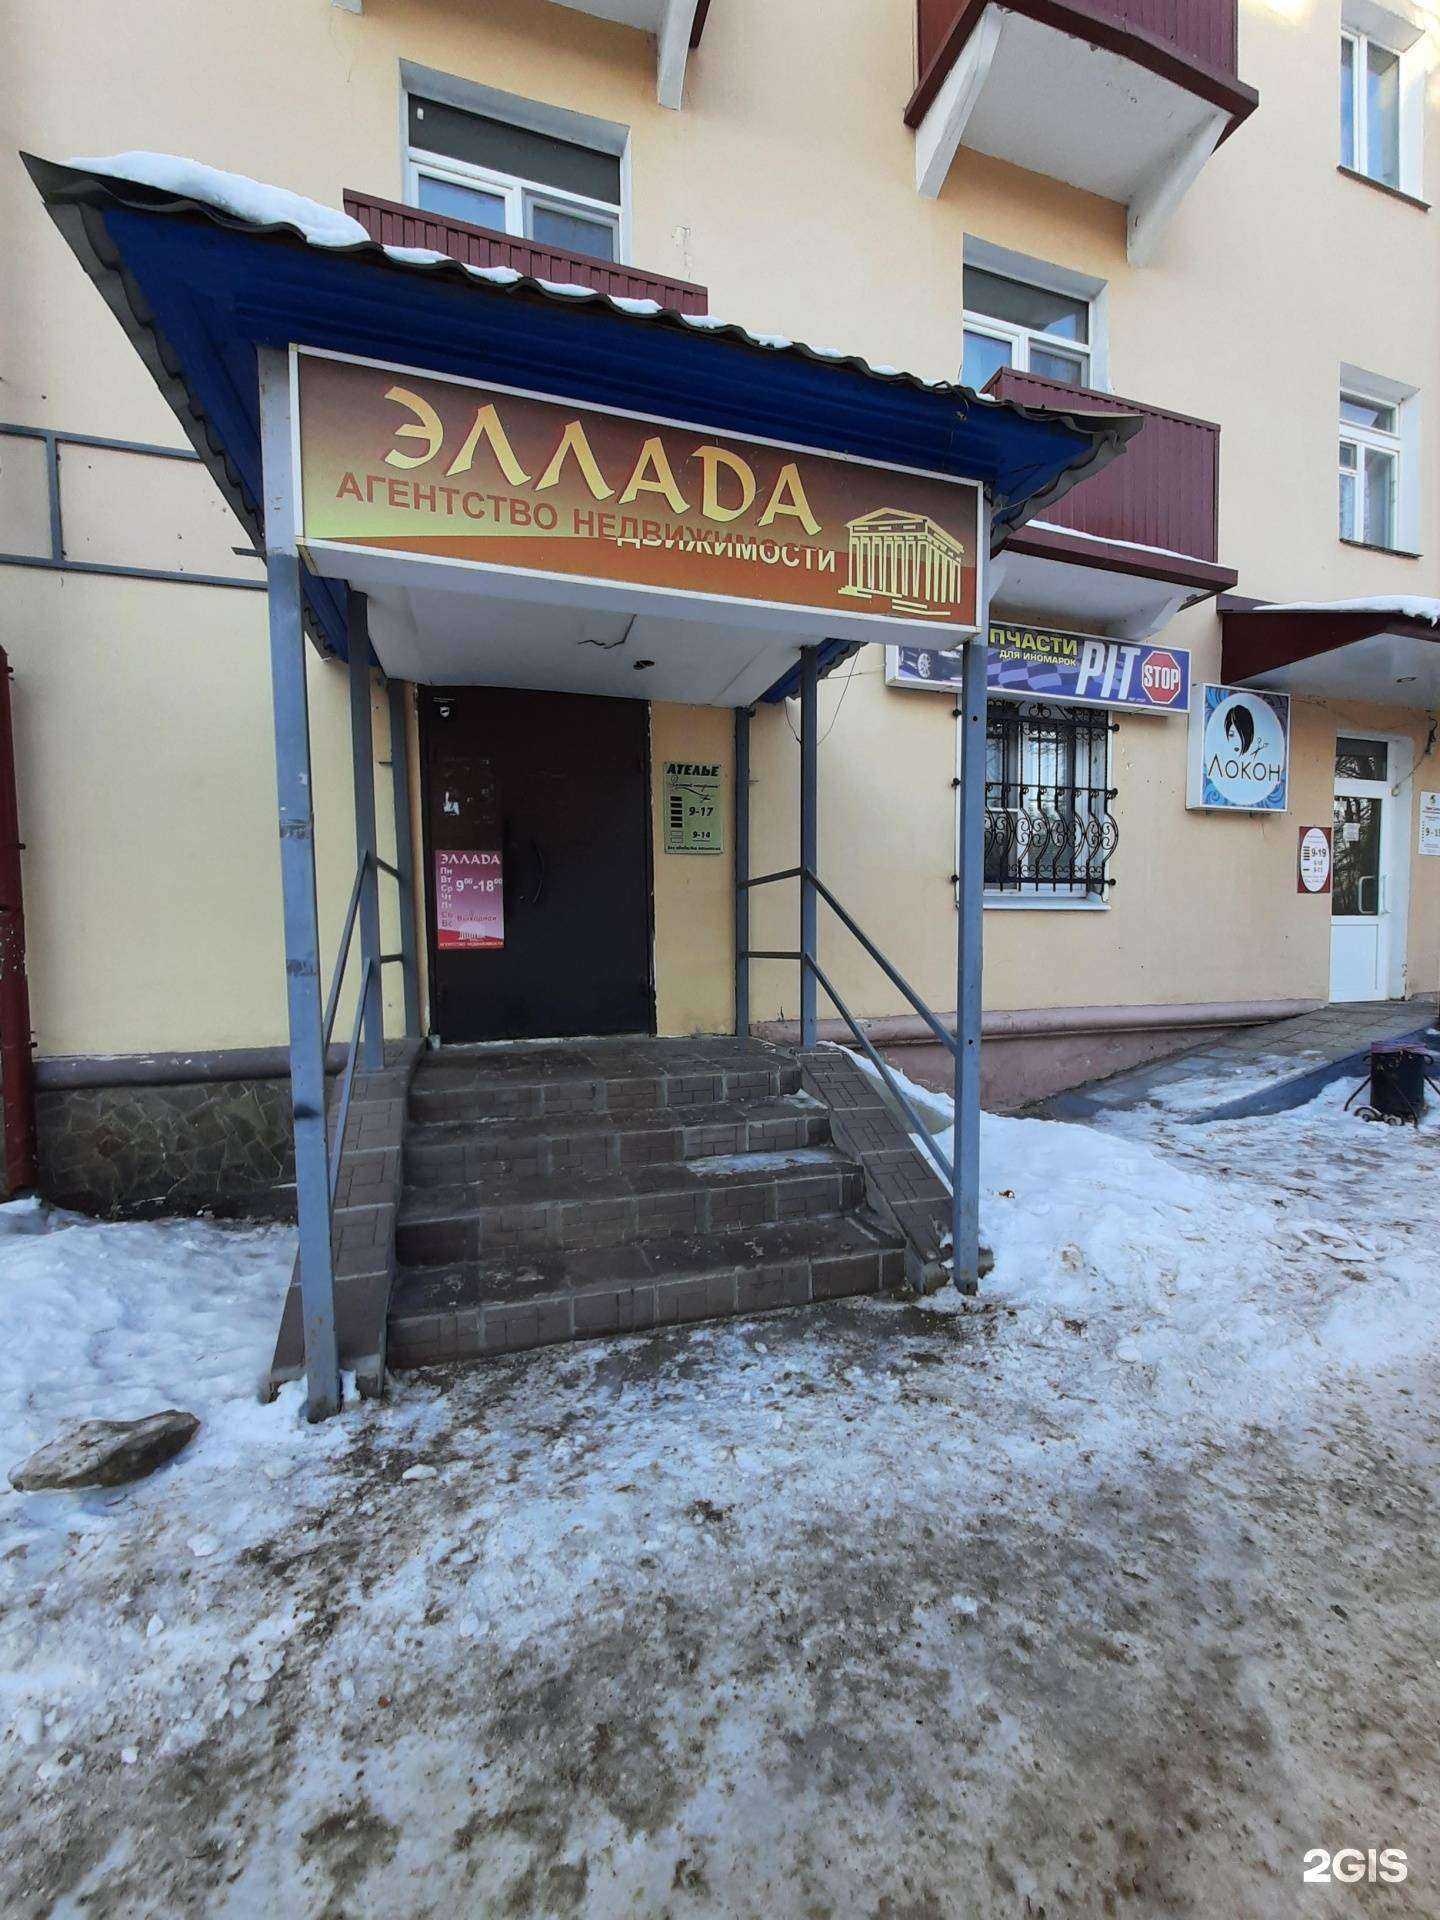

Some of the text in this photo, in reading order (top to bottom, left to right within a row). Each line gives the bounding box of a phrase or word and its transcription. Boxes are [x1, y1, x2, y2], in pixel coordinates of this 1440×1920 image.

[336, 472, 836, 573] АГЕНТСТВО НЕДВИЖИМОСТИ
[990, 627, 1077, 656] ПЧАСТИ
[1000, 649, 1076, 667] ДЛЯ ИНОМАРОК
[1075, 640, 1180, 700] PIT STOP
[667, 764, 719, 776] АТЕЛЬЕ
[1208, 753, 1281, 782] ЛОКОН
[689, 807, 713, 816] 9-17
